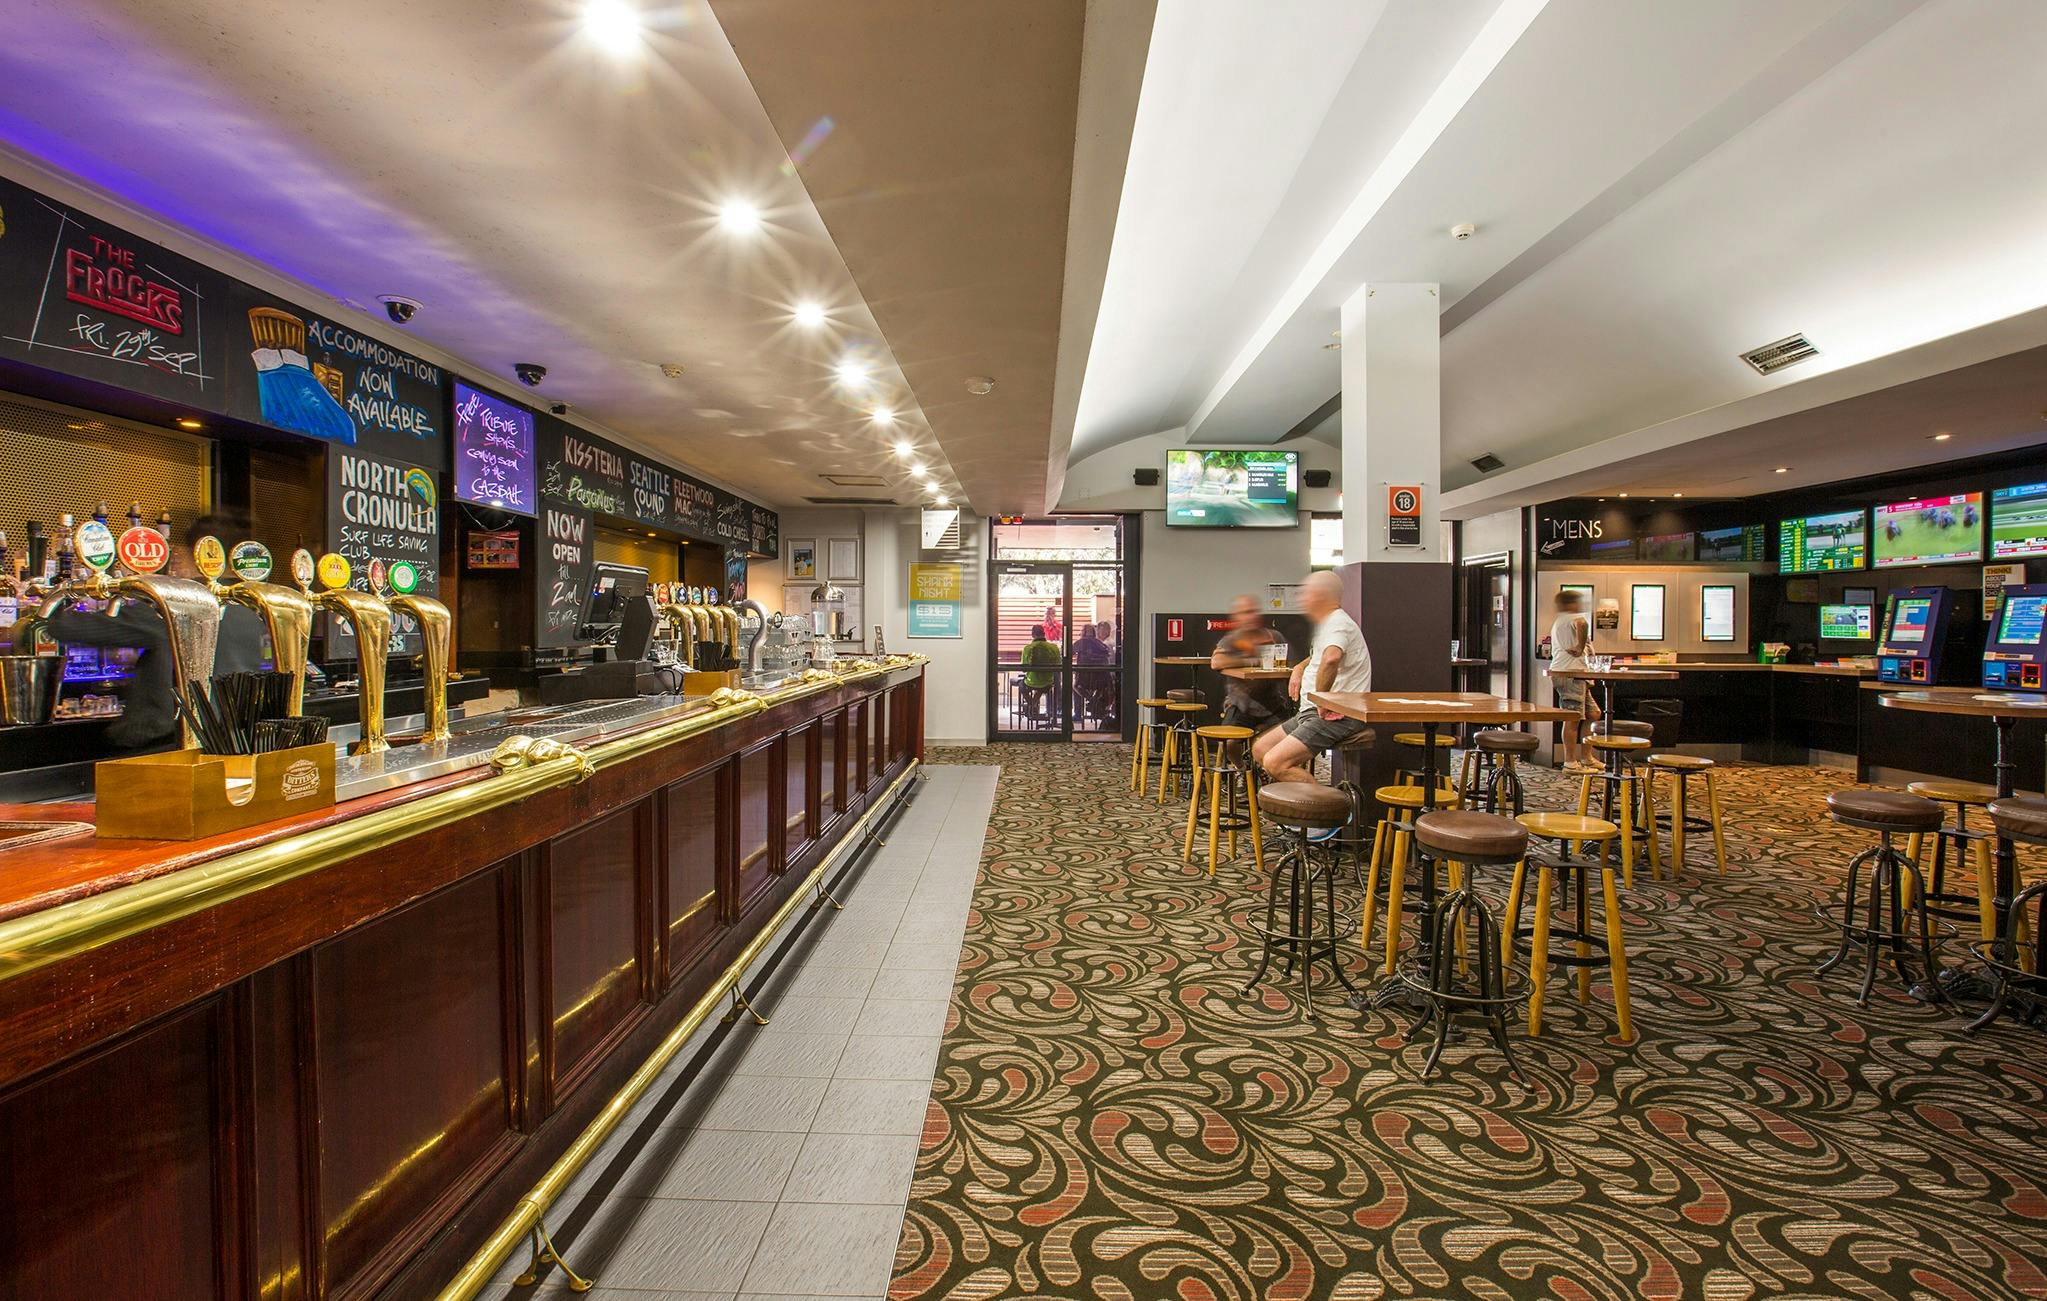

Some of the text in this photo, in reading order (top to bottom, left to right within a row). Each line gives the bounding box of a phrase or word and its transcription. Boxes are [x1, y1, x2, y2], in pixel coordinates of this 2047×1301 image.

[90, 234, 135, 269] THE
[66, 247, 182, 334] FROCKS
[308, 320, 439, 386] ACCOMMODATION
[359, 367, 395, 400] NOW
[347, 393, 434, 435] AVAILABLE
[480, 407, 519, 435] TRIBUTE
[564, 435, 624, 480] KISSTERIA
[340, 455, 409, 499] NORTH
[629, 460, 670, 496] SEATTLE
[633, 487, 665, 518] SOUND
[672, 478, 714, 506] FLEETWOOD
[674, 497, 692, 516] MAC
[1398, 498, 1411, 509] 18
[342, 490, 437, 535] CRONULLA
[547, 509, 584, 544] NOW
[372, 533, 394, 548] LIFE
[398, 536, 428, 552] SAVING
[717, 521, 732, 537] COLD
[1553, 519, 1603, 539] MENS
[124, 542, 165, 558] OLD
[339, 544, 371, 560] CLUB
[552, 542, 581, 564] OPEN
[918, 587, 951, 599] NIGHT
